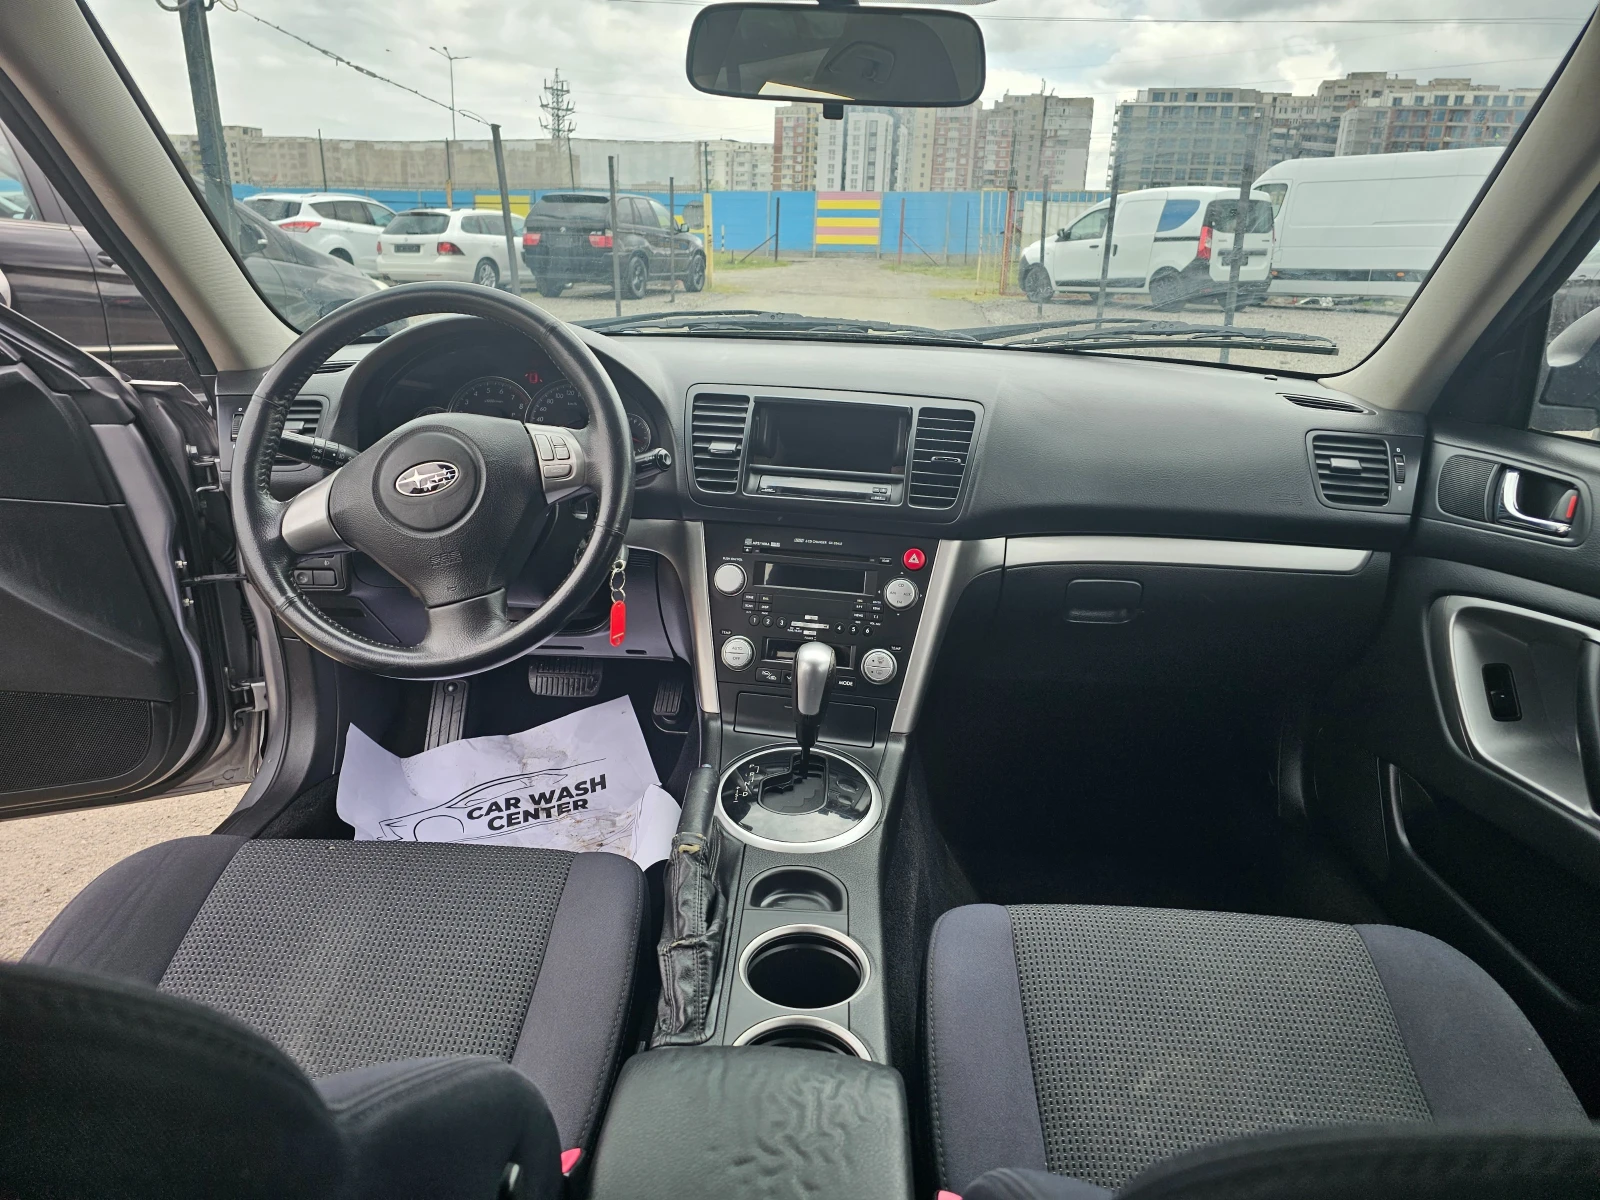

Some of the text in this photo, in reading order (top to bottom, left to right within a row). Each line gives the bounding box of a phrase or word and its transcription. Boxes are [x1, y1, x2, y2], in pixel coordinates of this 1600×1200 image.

[466, 774, 606, 820] CAR WASH
[488, 798, 588, 830] CENTER
